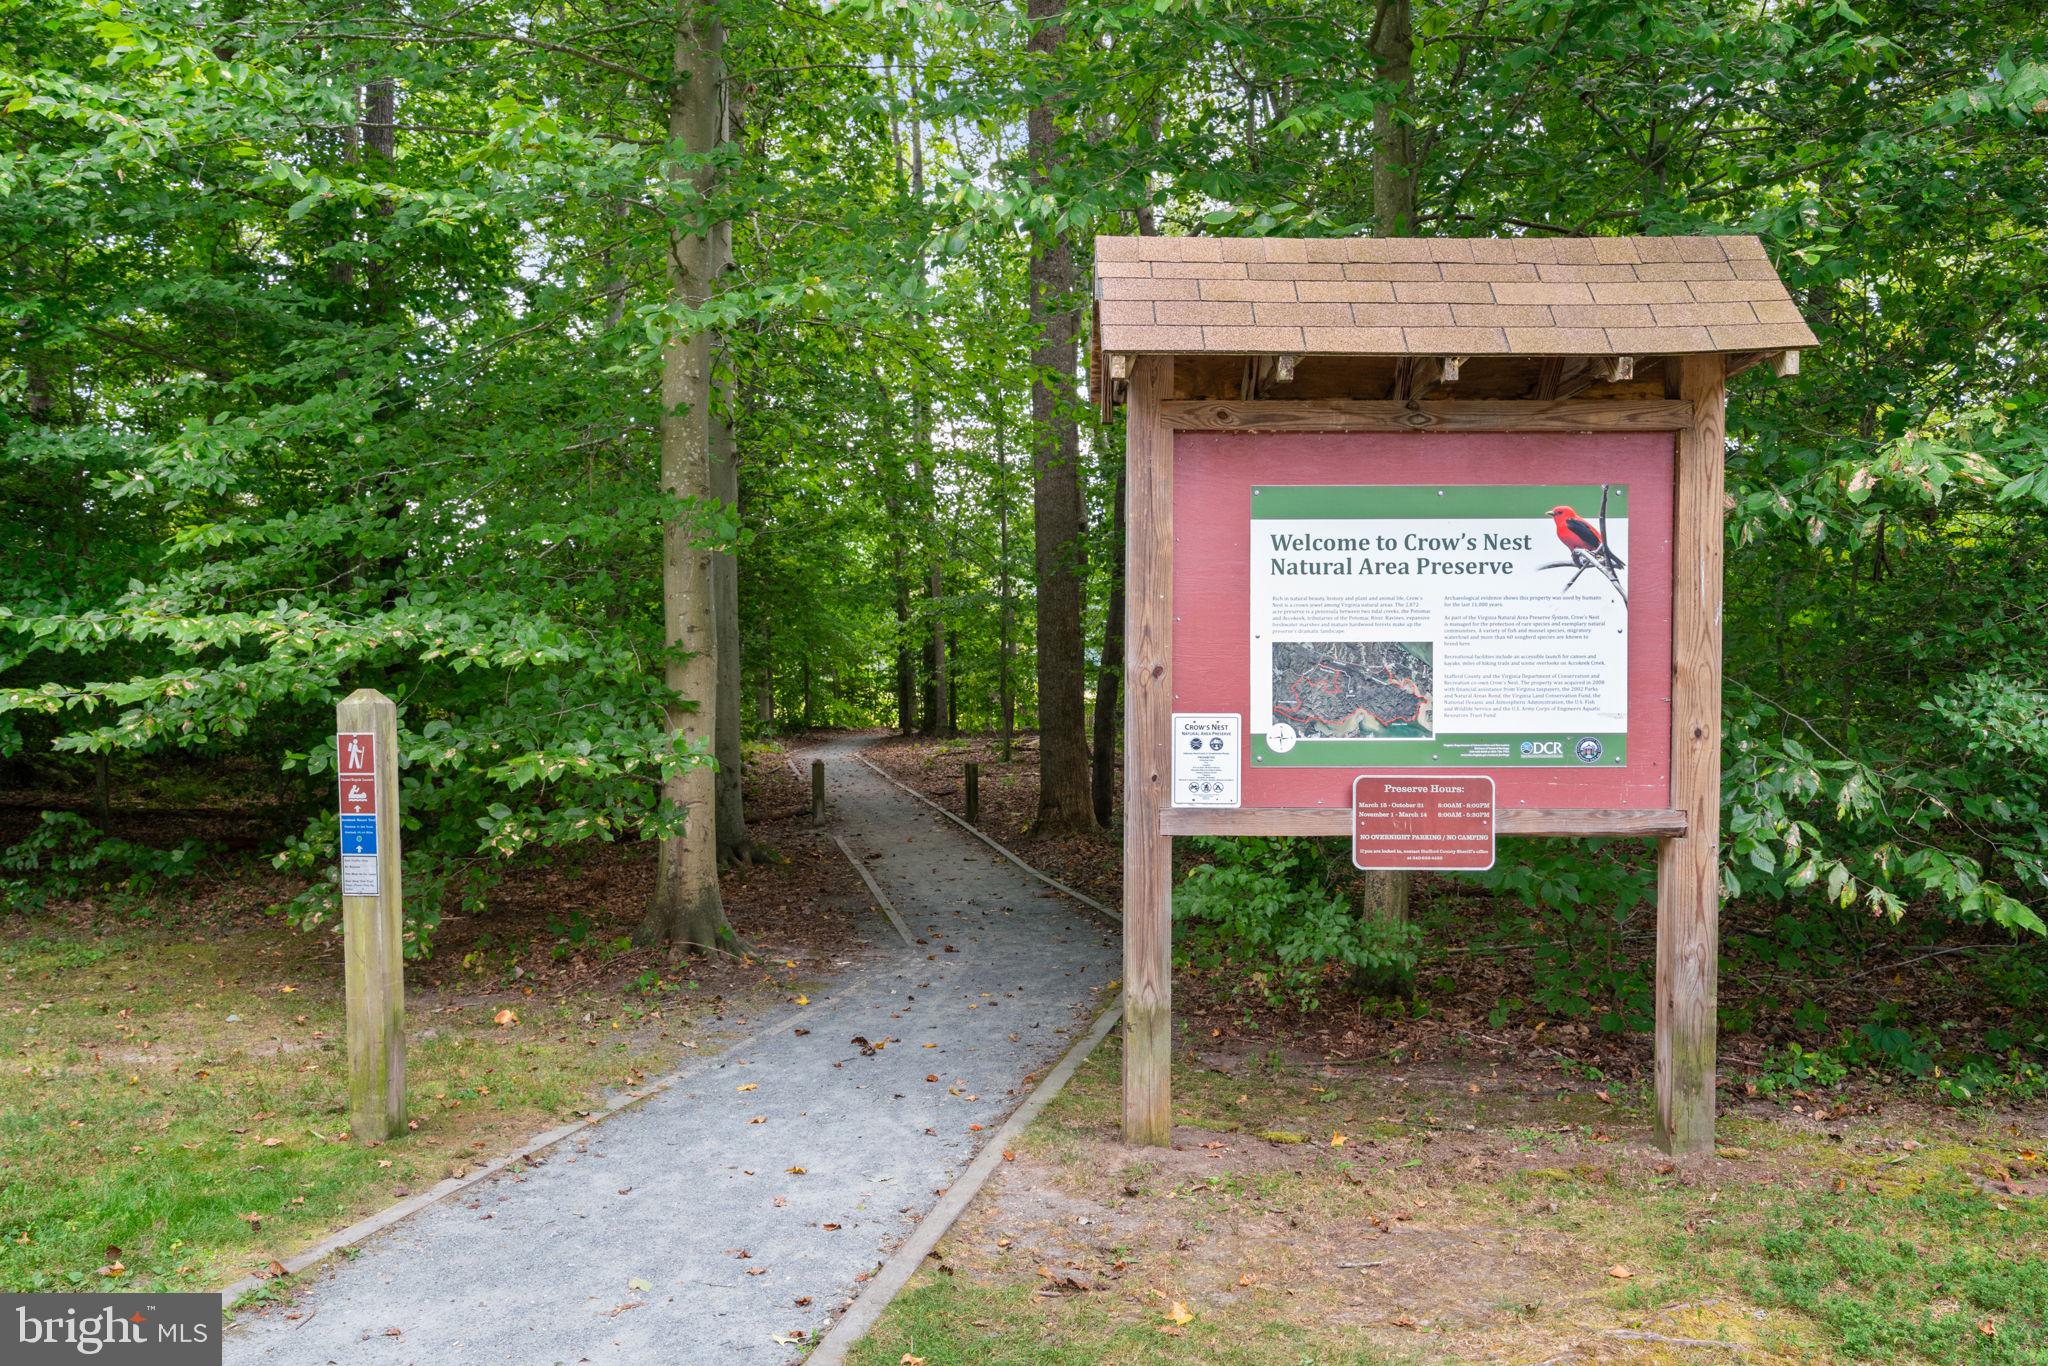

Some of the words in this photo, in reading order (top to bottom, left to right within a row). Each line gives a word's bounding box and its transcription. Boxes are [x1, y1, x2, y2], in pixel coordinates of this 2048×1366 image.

[1270, 534, 1370, 551] Welcome
[1376, 536, 1397, 551] to
[1404, 533, 1477, 551] Crow’s
[1484, 533, 1532, 550] Nest
[1271, 557, 1352, 575] Natural
[1359, 558, 1409, 575] Area
[1416, 558, 1514, 575] Preserve
[1533, 742, 1563, 754] DCR
[1384, 784, 1428, 793] Preserve
[1430, 784, 1465, 793] Hours:
